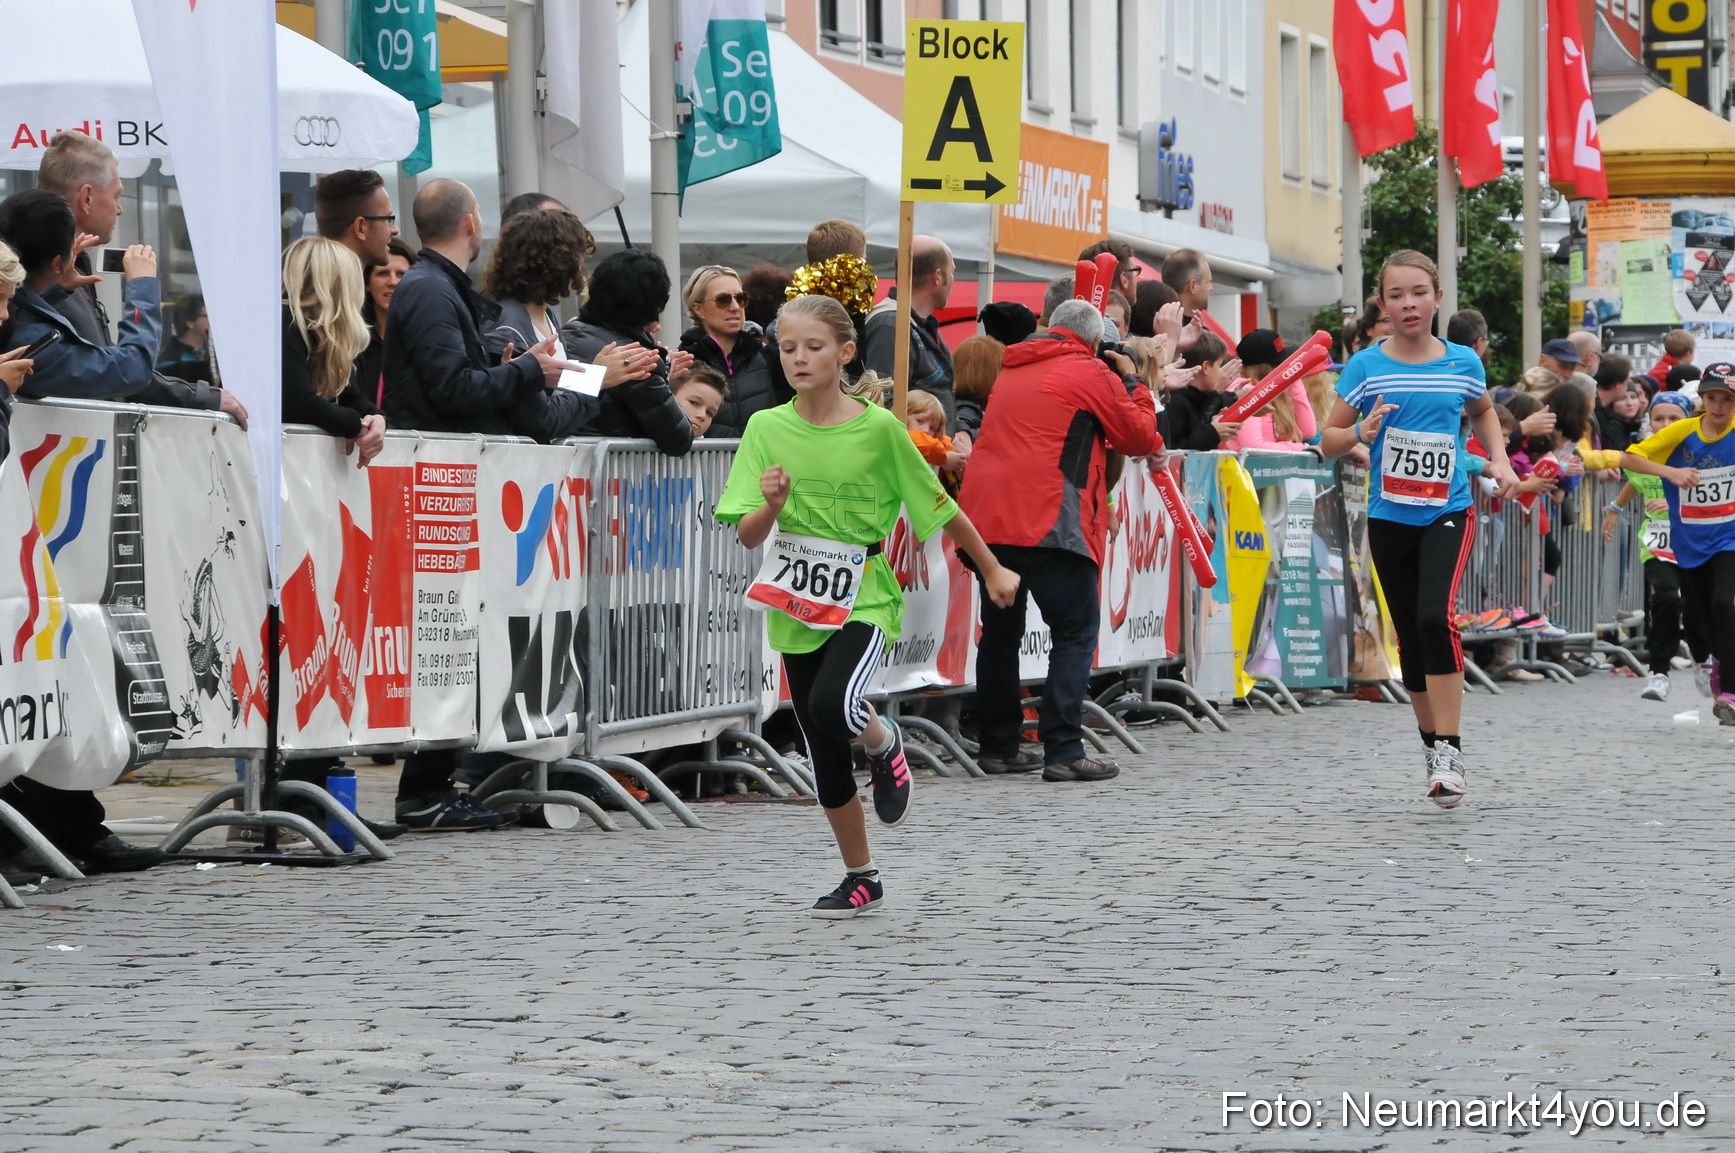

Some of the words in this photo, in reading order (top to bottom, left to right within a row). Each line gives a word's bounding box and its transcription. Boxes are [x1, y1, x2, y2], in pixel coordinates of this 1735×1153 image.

[721, 40, 768, 78] Se
[918, 26, 1010, 61] Block
[723, 89, 772, 127] 09
[925, 75, 994, 163] A
[1238, 395, 1259, 415] Audi
[1259, 380, 1279, 399] BKK
[1386, 433, 1410, 445] PARTL
[1410, 438, 1447, 448] Neumarkt
[1390, 446, 1450, 479] 7599
[1699, 473, 1728, 481] eumarkt
[1158, 485, 1175, 509] Audi
[1170, 508, 1185, 531] BKK
[774, 539, 798, 553] PARTL
[799, 545, 849, 562] Neumarkt
[772, 554, 853, 602] 7060
[418, 589, 443, 604] Braun
[786, 598, 812, 618] Mia
[418, 608, 429, 623] Am
[418, 627, 450, 642] D-92318
[903, 631, 935, 665] Radio
[293, 634, 327, 699] Braun
[417, 672, 428, 687] Fax
